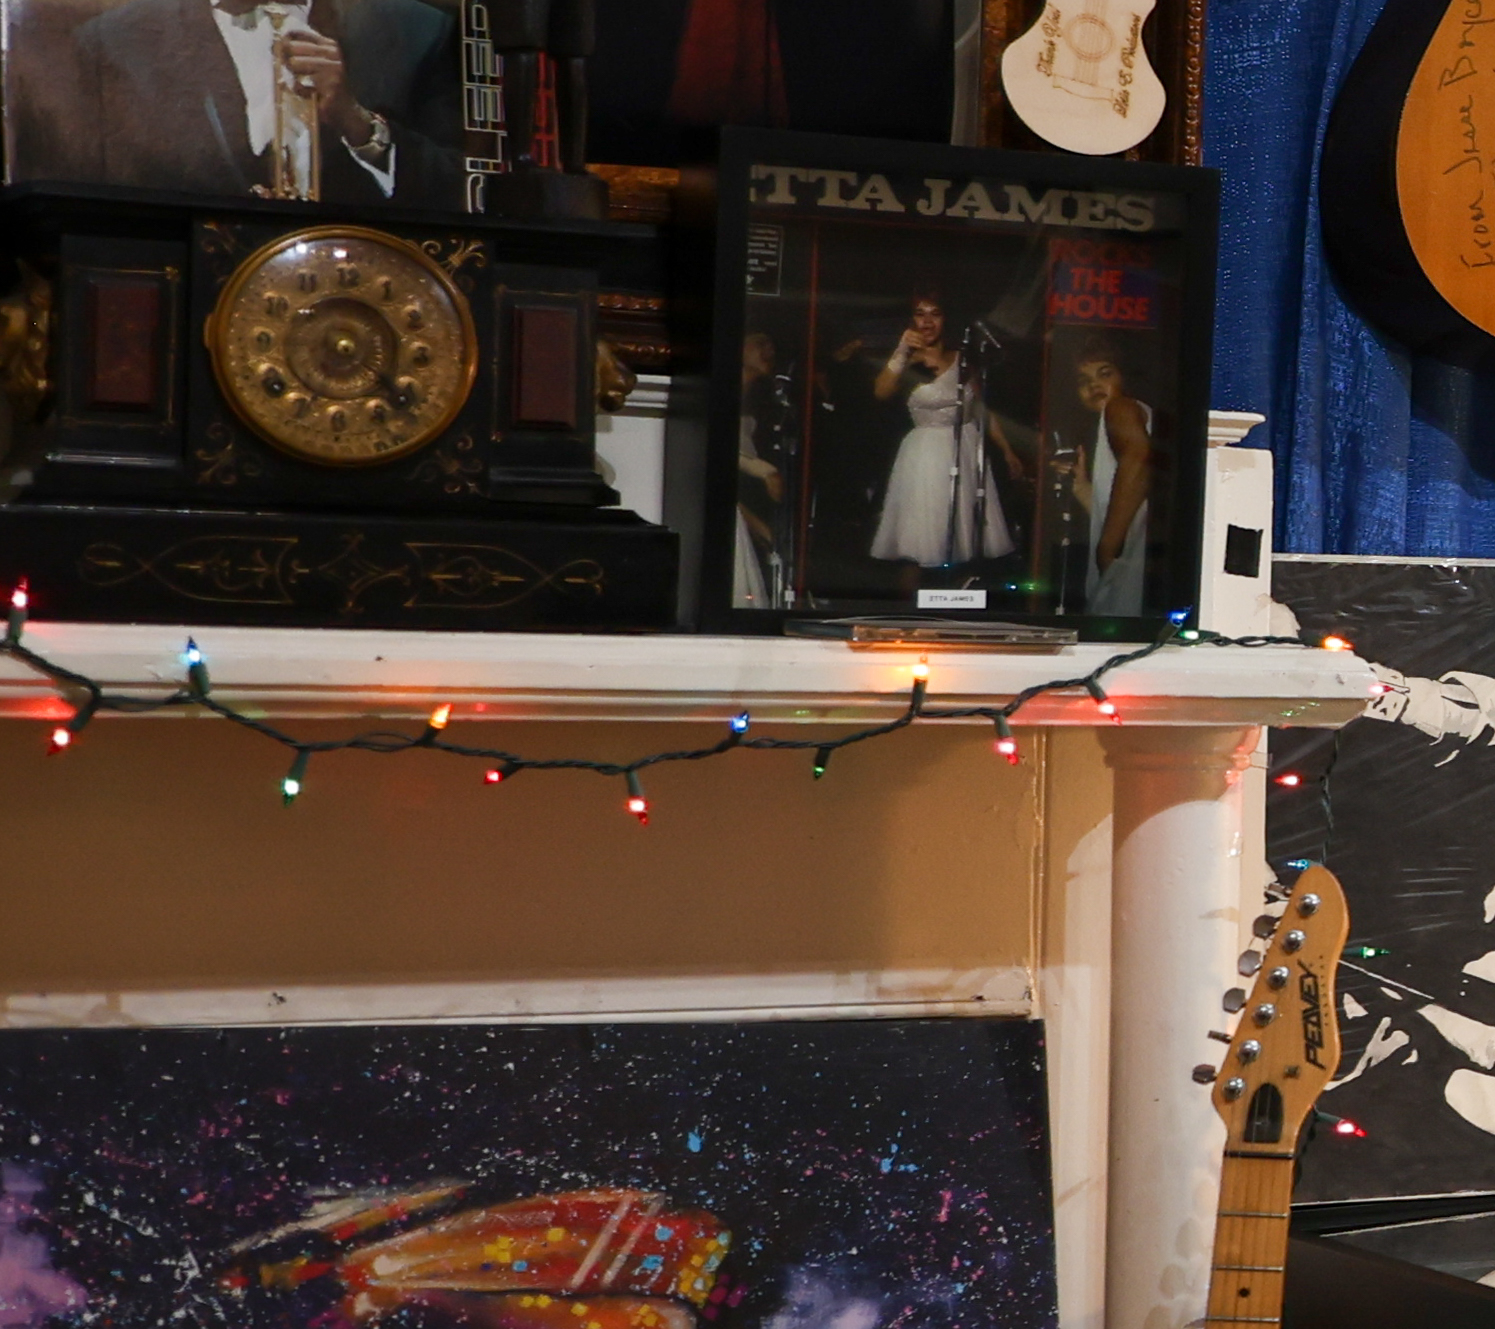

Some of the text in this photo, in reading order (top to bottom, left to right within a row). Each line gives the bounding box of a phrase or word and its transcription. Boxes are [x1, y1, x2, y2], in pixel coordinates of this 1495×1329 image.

[916, 177, 1155, 234] JAMES
[1071, 270, 1123, 295] THE
[1048, 294, 1150, 322] HOUSE
[1296, 958, 1328, 1071] PEAVEY
